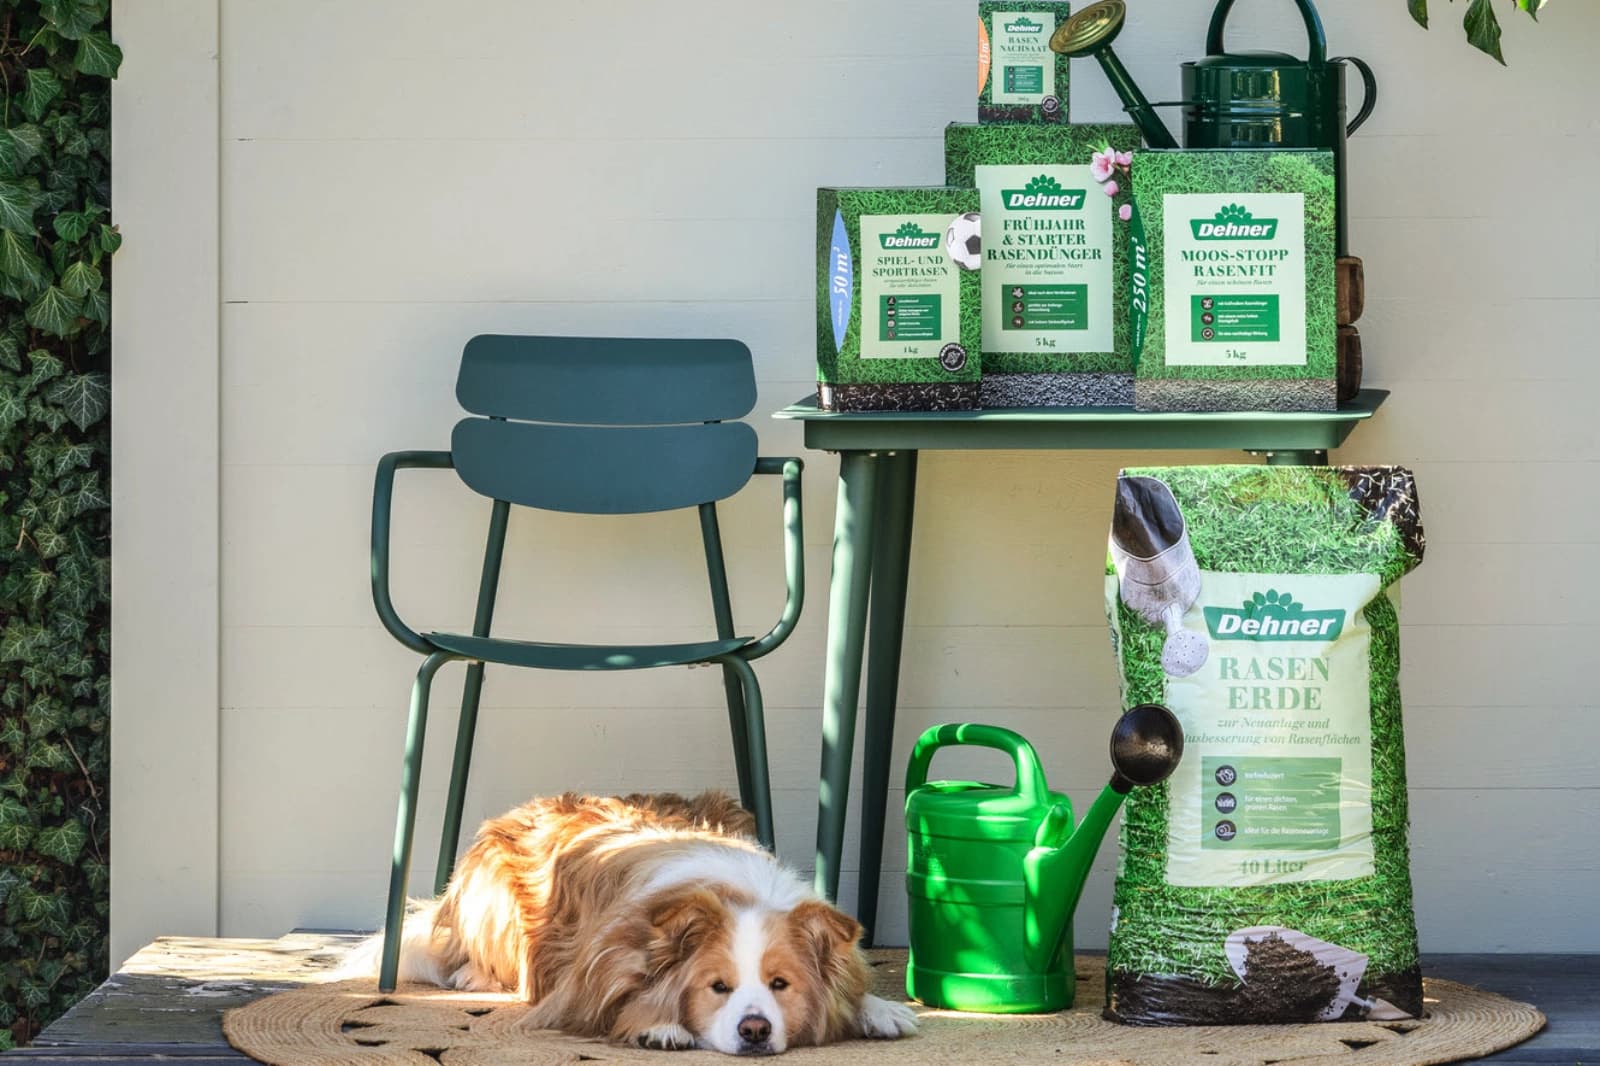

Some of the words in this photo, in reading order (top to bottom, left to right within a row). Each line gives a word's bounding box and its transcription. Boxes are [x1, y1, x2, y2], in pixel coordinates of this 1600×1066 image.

[1006, 24, 1041, 32] Dehner
[1009, 193, 1081, 207] Dehner
[1003, 216, 1085, 231] FRÜHJAHR
[1198, 222, 1273, 237] Dehner
[885, 236, 937, 247] Dehner
[1002, 234, 1013, 246] &
[1018, 234, 1086, 246] STARTER
[987, 246, 1102, 260] RASENDÜNGER
[1181, 249, 1289, 261] MOOS-STOPP
[877, 256, 915, 266] SPIEL-
[918, 255, 943, 265] UND
[872, 266, 948, 277] SPORTRASEN
[1193, 265, 1276, 277] RASENFIT
[833, 275, 849, 299] 50
[1132, 272, 1146, 314] 250
[1035, 337, 1041, 346] 5
[1043, 337, 1056, 347] kg
[908, 346, 918, 354] kg
[1226, 349, 1231, 358] 5
[1233, 349, 1247, 360] kg
[1216, 614, 1336, 636] Dehner
[1218, 656, 1330, 681] RASEN
[1228, 686, 1322, 710] ERDE
[1217, 719, 1237, 728] zur
[1241, 717, 1305, 729] Neuanlage
[1307, 718, 1330, 728] und
[1263, 735, 1286, 744] von
[1288, 733, 1360, 746] Rasenflächen
[1264, 858, 1308, 873] Liter
